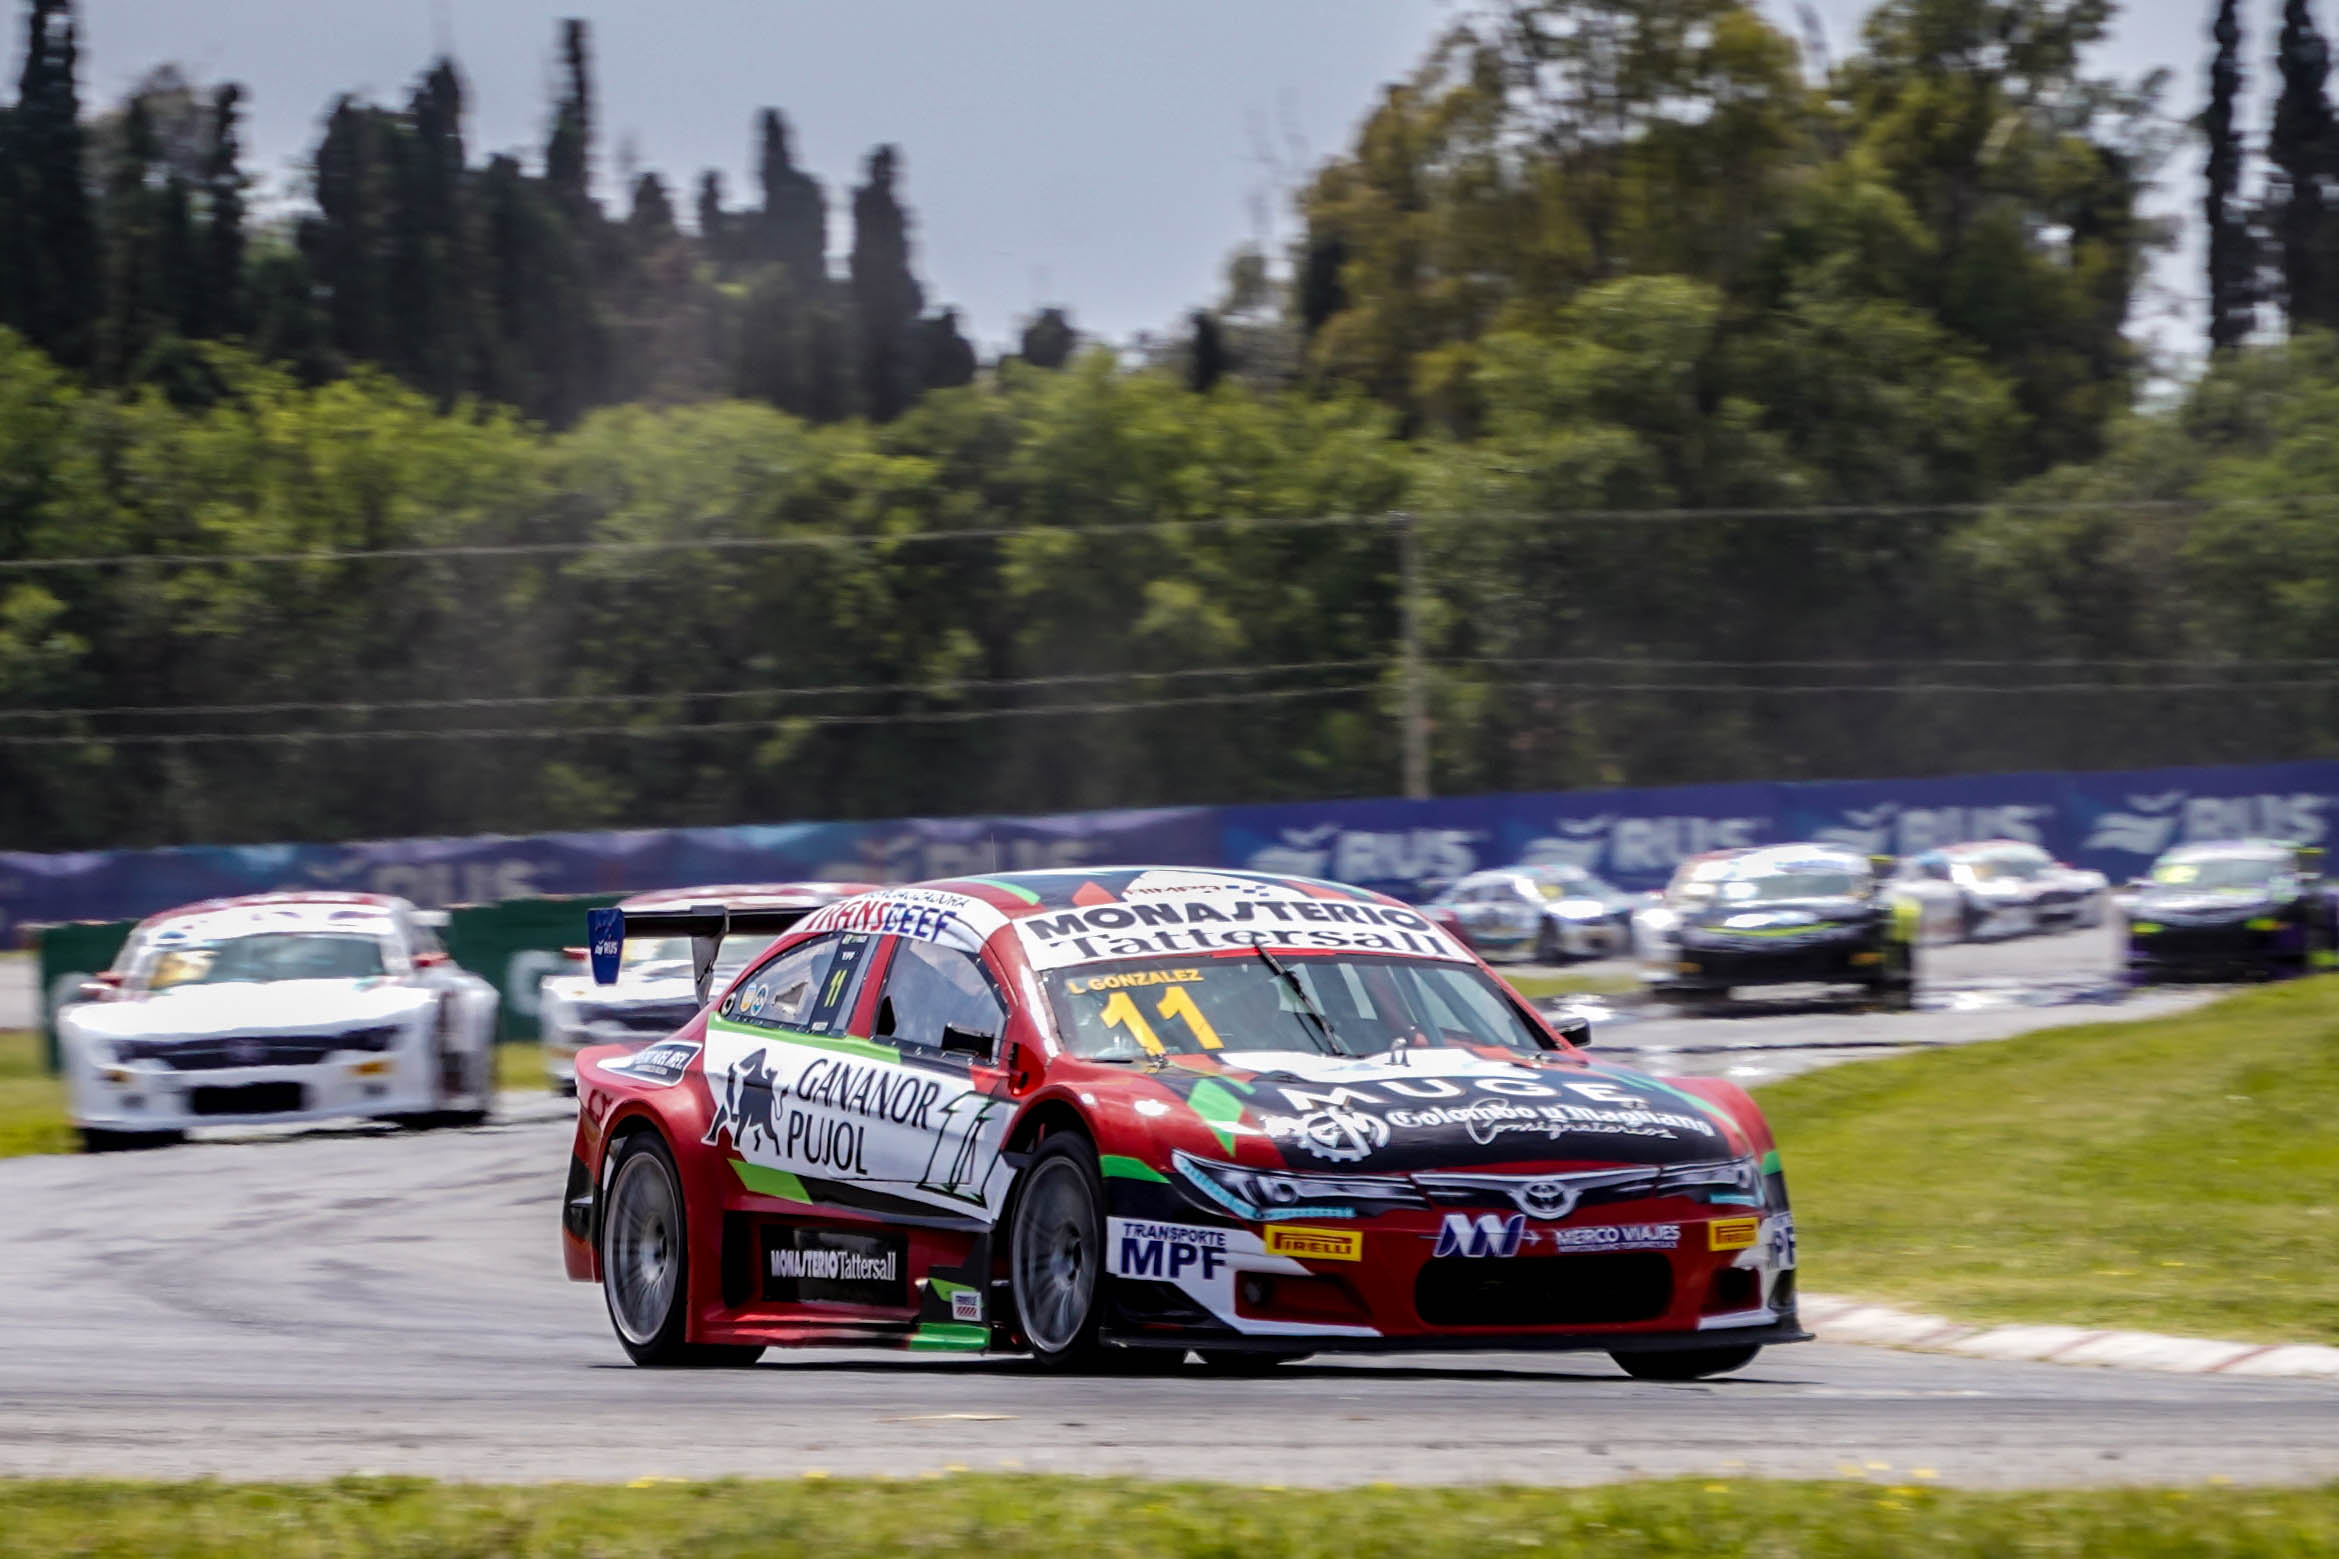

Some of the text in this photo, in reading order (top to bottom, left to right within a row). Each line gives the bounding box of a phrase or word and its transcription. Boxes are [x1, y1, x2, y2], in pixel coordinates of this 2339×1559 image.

[1025, 900, 1431, 940] MONASTERIO
[1049, 928, 1450, 959] Tattersall
[1088, 968, 1206, 991] GONZALEZ
[1100, 985, 1225, 1057] 11
[796, 1057, 940, 1130] GANANOR
[1277, 1078, 1648, 1111] MUGE
[787, 1109, 868, 1176] PUJOL
[1122, 1223, 1226, 1246] TRANSPORTE
[1273, 1232, 1353, 1254] PIRELLI
[1556, 1225, 1681, 1245] MERCO VIAJES
[1120, 1238, 1227, 1280] MPF
